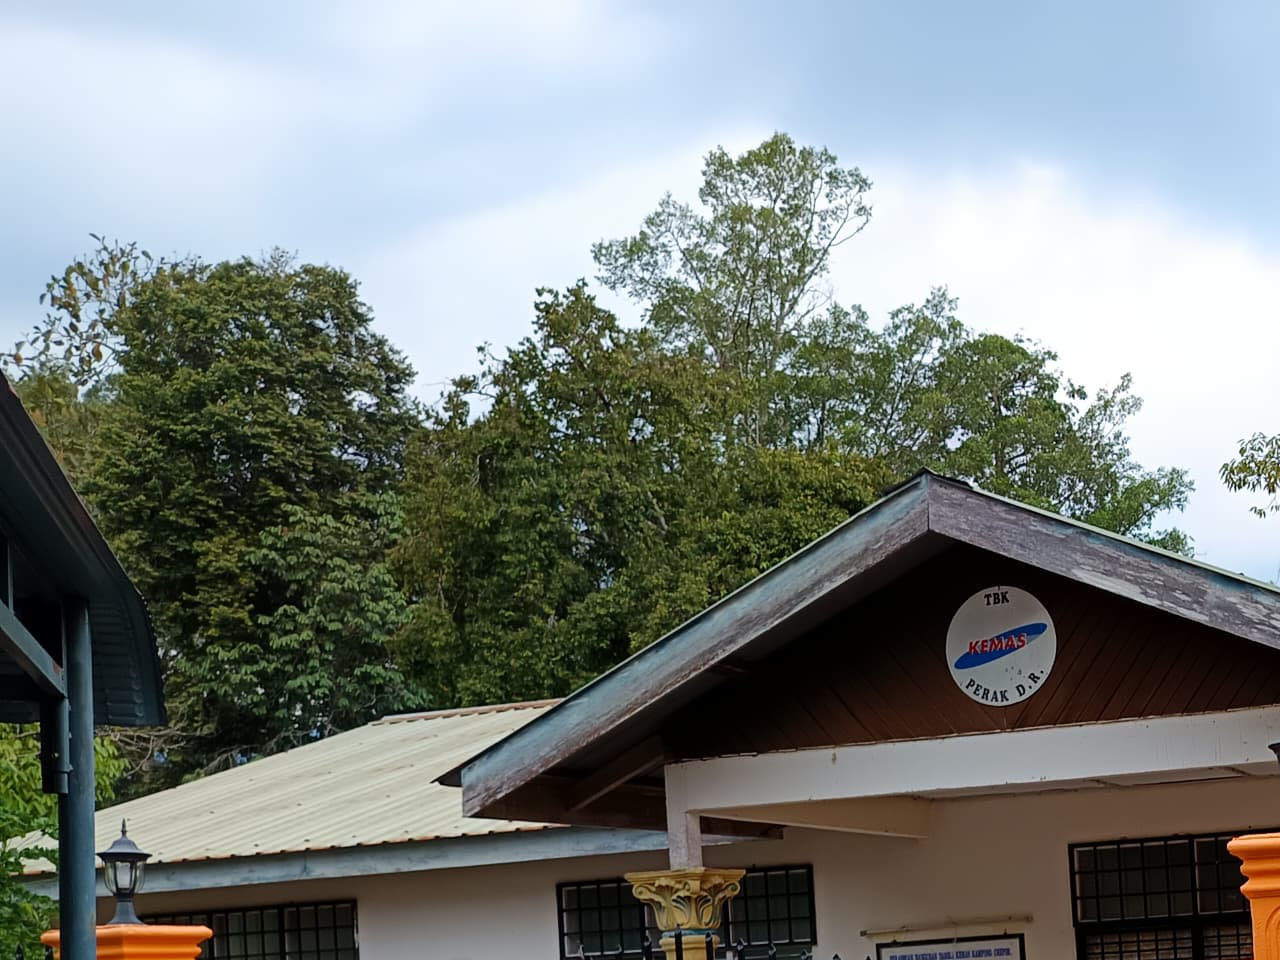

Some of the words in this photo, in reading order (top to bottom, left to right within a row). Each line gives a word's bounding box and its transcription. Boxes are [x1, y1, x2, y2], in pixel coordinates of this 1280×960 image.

[984, 591, 1010, 606] TBK
[968, 633, 1027, 655] KEMAS
[965, 678, 1009, 702] PERAK
[1015, 670, 1044, 697] D.R.
